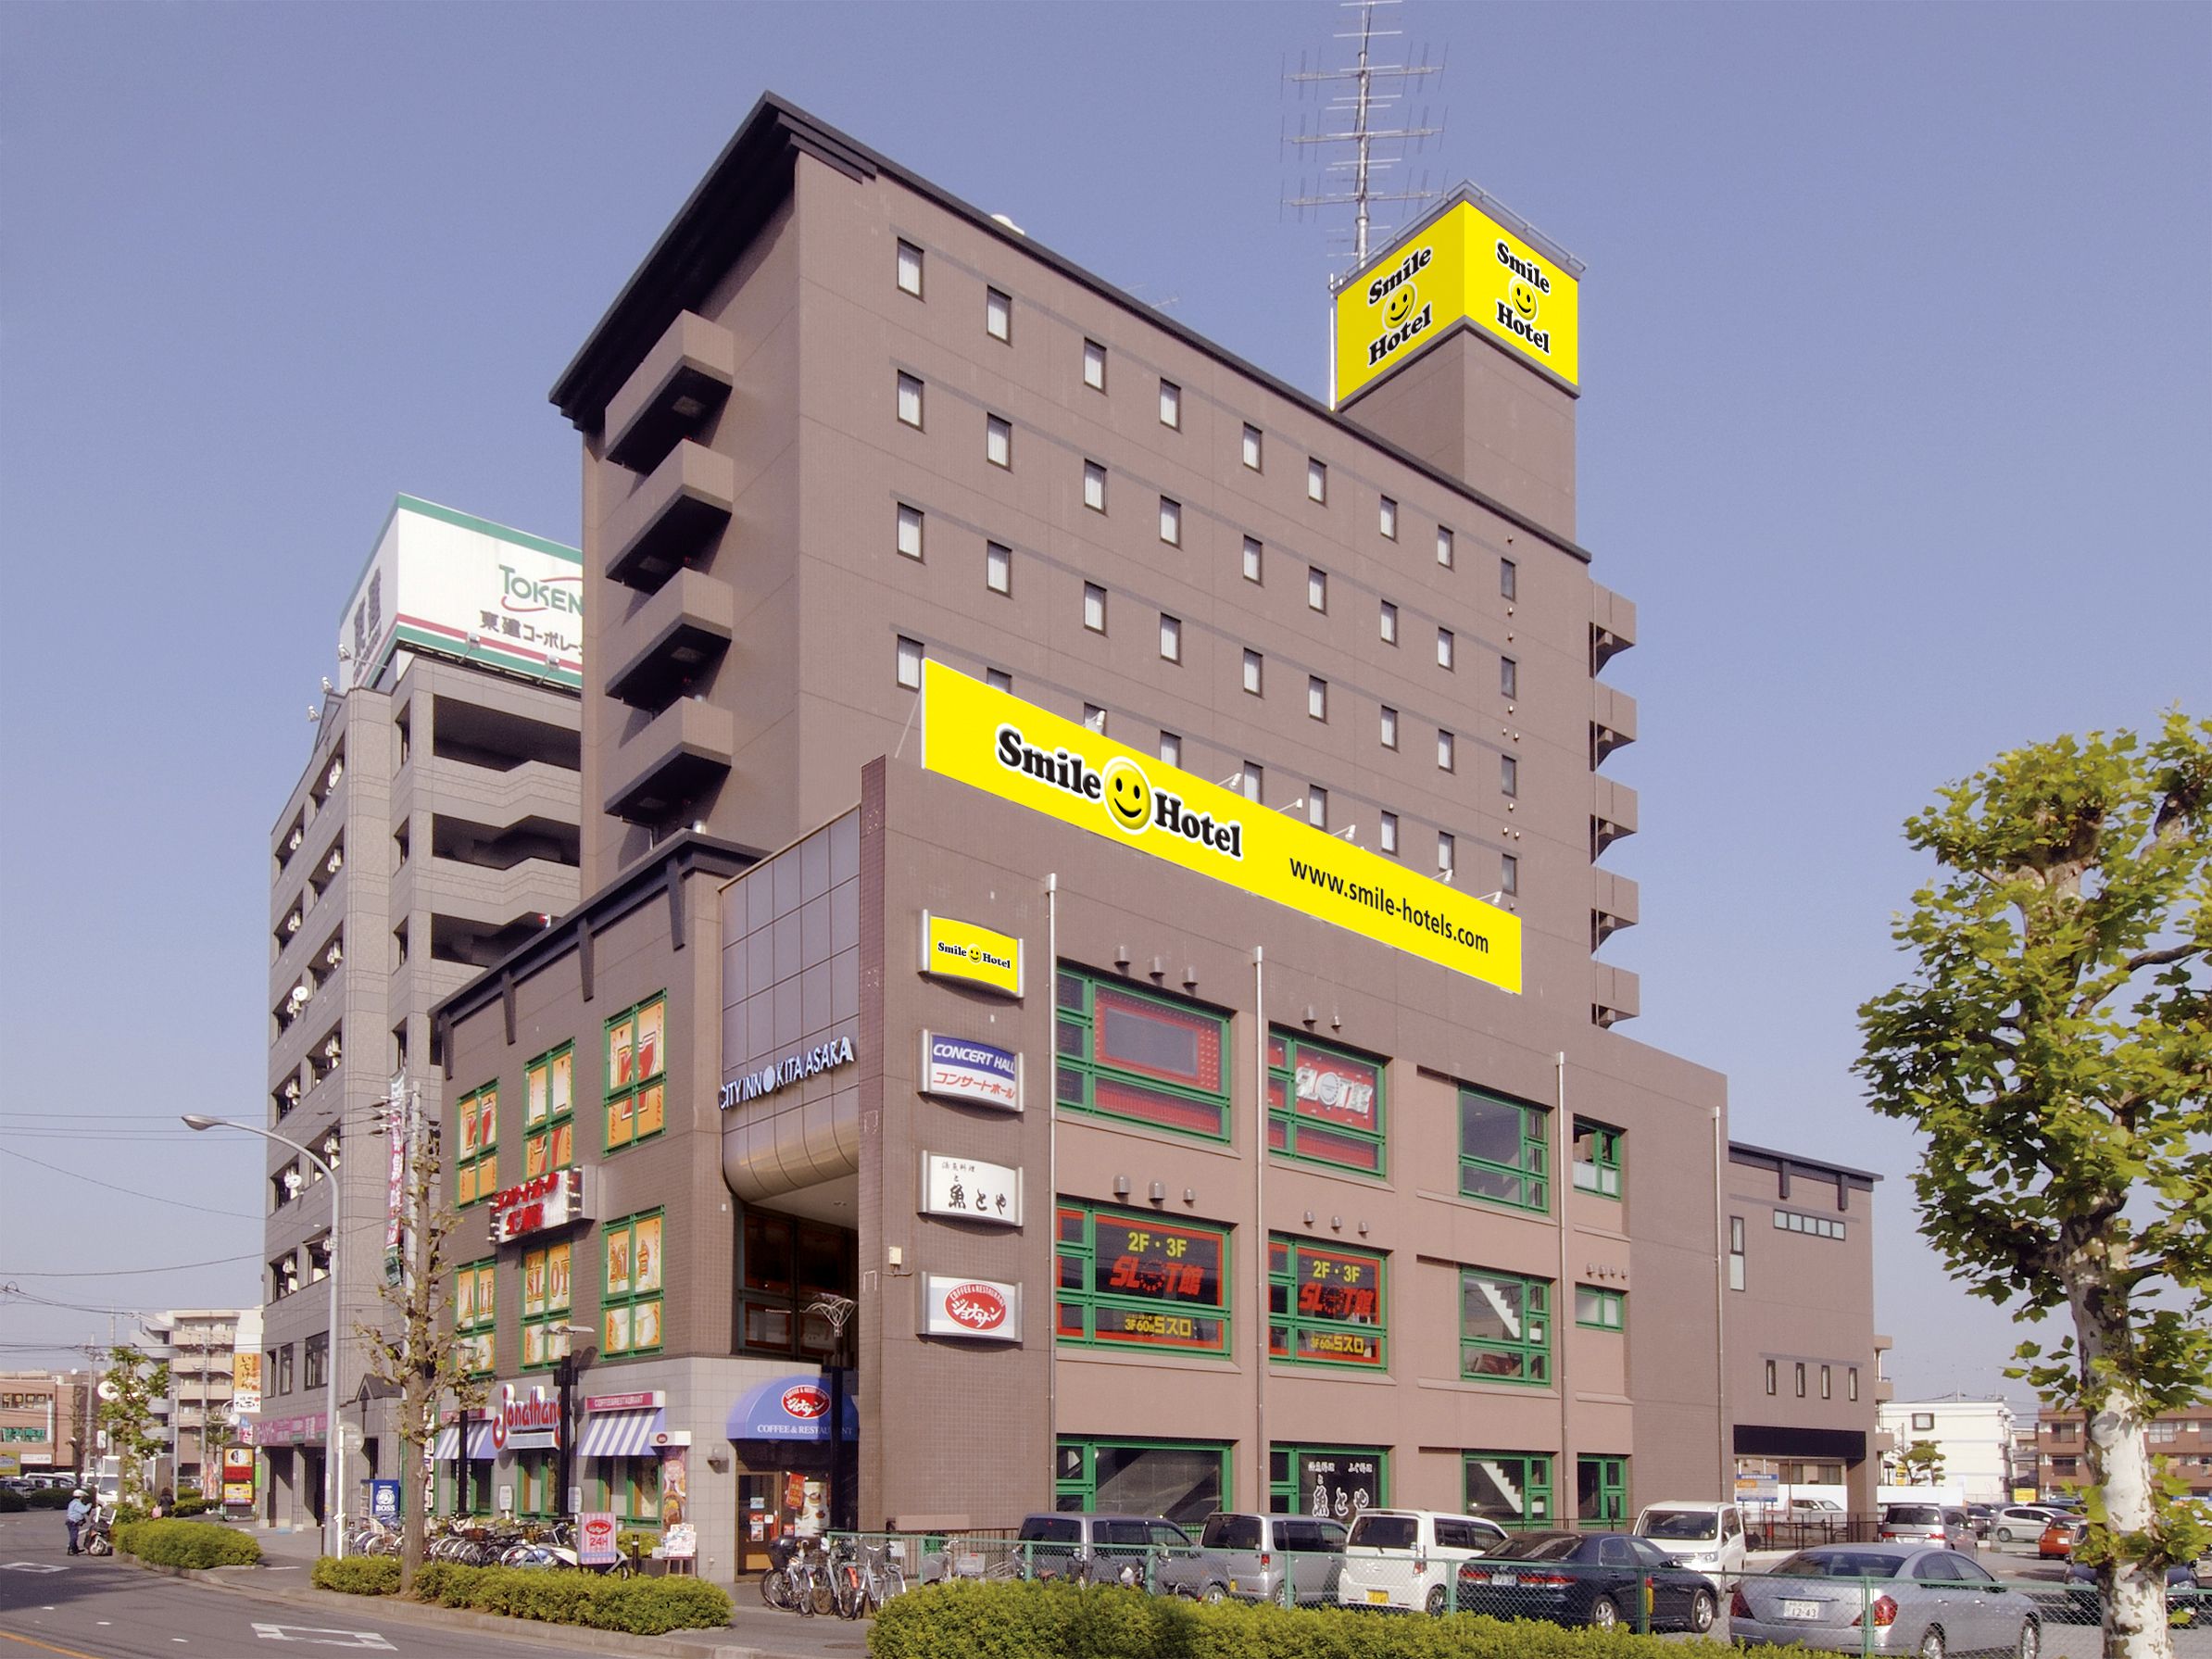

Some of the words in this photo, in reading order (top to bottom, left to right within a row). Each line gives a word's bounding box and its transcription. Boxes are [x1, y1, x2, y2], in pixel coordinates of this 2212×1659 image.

[1368, 247, 1432, 305] Smile
[1496, 242, 1550, 294] Smile
[1368, 303, 1432, 366] Hotel
[1496, 301, 1550, 354] Hotel
[479, 609, 582, 658] 東建コーポレー
[998, 728, 1101, 800] Smile
[1154, 791, 1242, 859] Hotel
[1289, 857, 1490, 955] www.smile-hotels.com
[937, 941, 967, 957] Smile
[982, 952, 1012, 970] Hotel
[719, 1080, 742, 1110] CITY
[742, 1071, 763, 1100] INN
[776, 1055, 804, 1088] KITA
[804, 1036, 855, 1077] ASAKA
[933, 1043, 994, 1066] CONCERT
[994, 1055, 1015, 1075] HALL
[933, 1072, 1015, 1100] コンサートホール
[949, 1285, 972, 1301] COFFEE
[975, 1285, 1006, 1307] RESTAURANT
[950, 1298, 1002, 1328] ジョナサン
[757, 1424, 790, 1434] COFFEE
[798, 1426, 852, 1435] RESTAUNT
[589, 1538, 609, 1547] 24H
